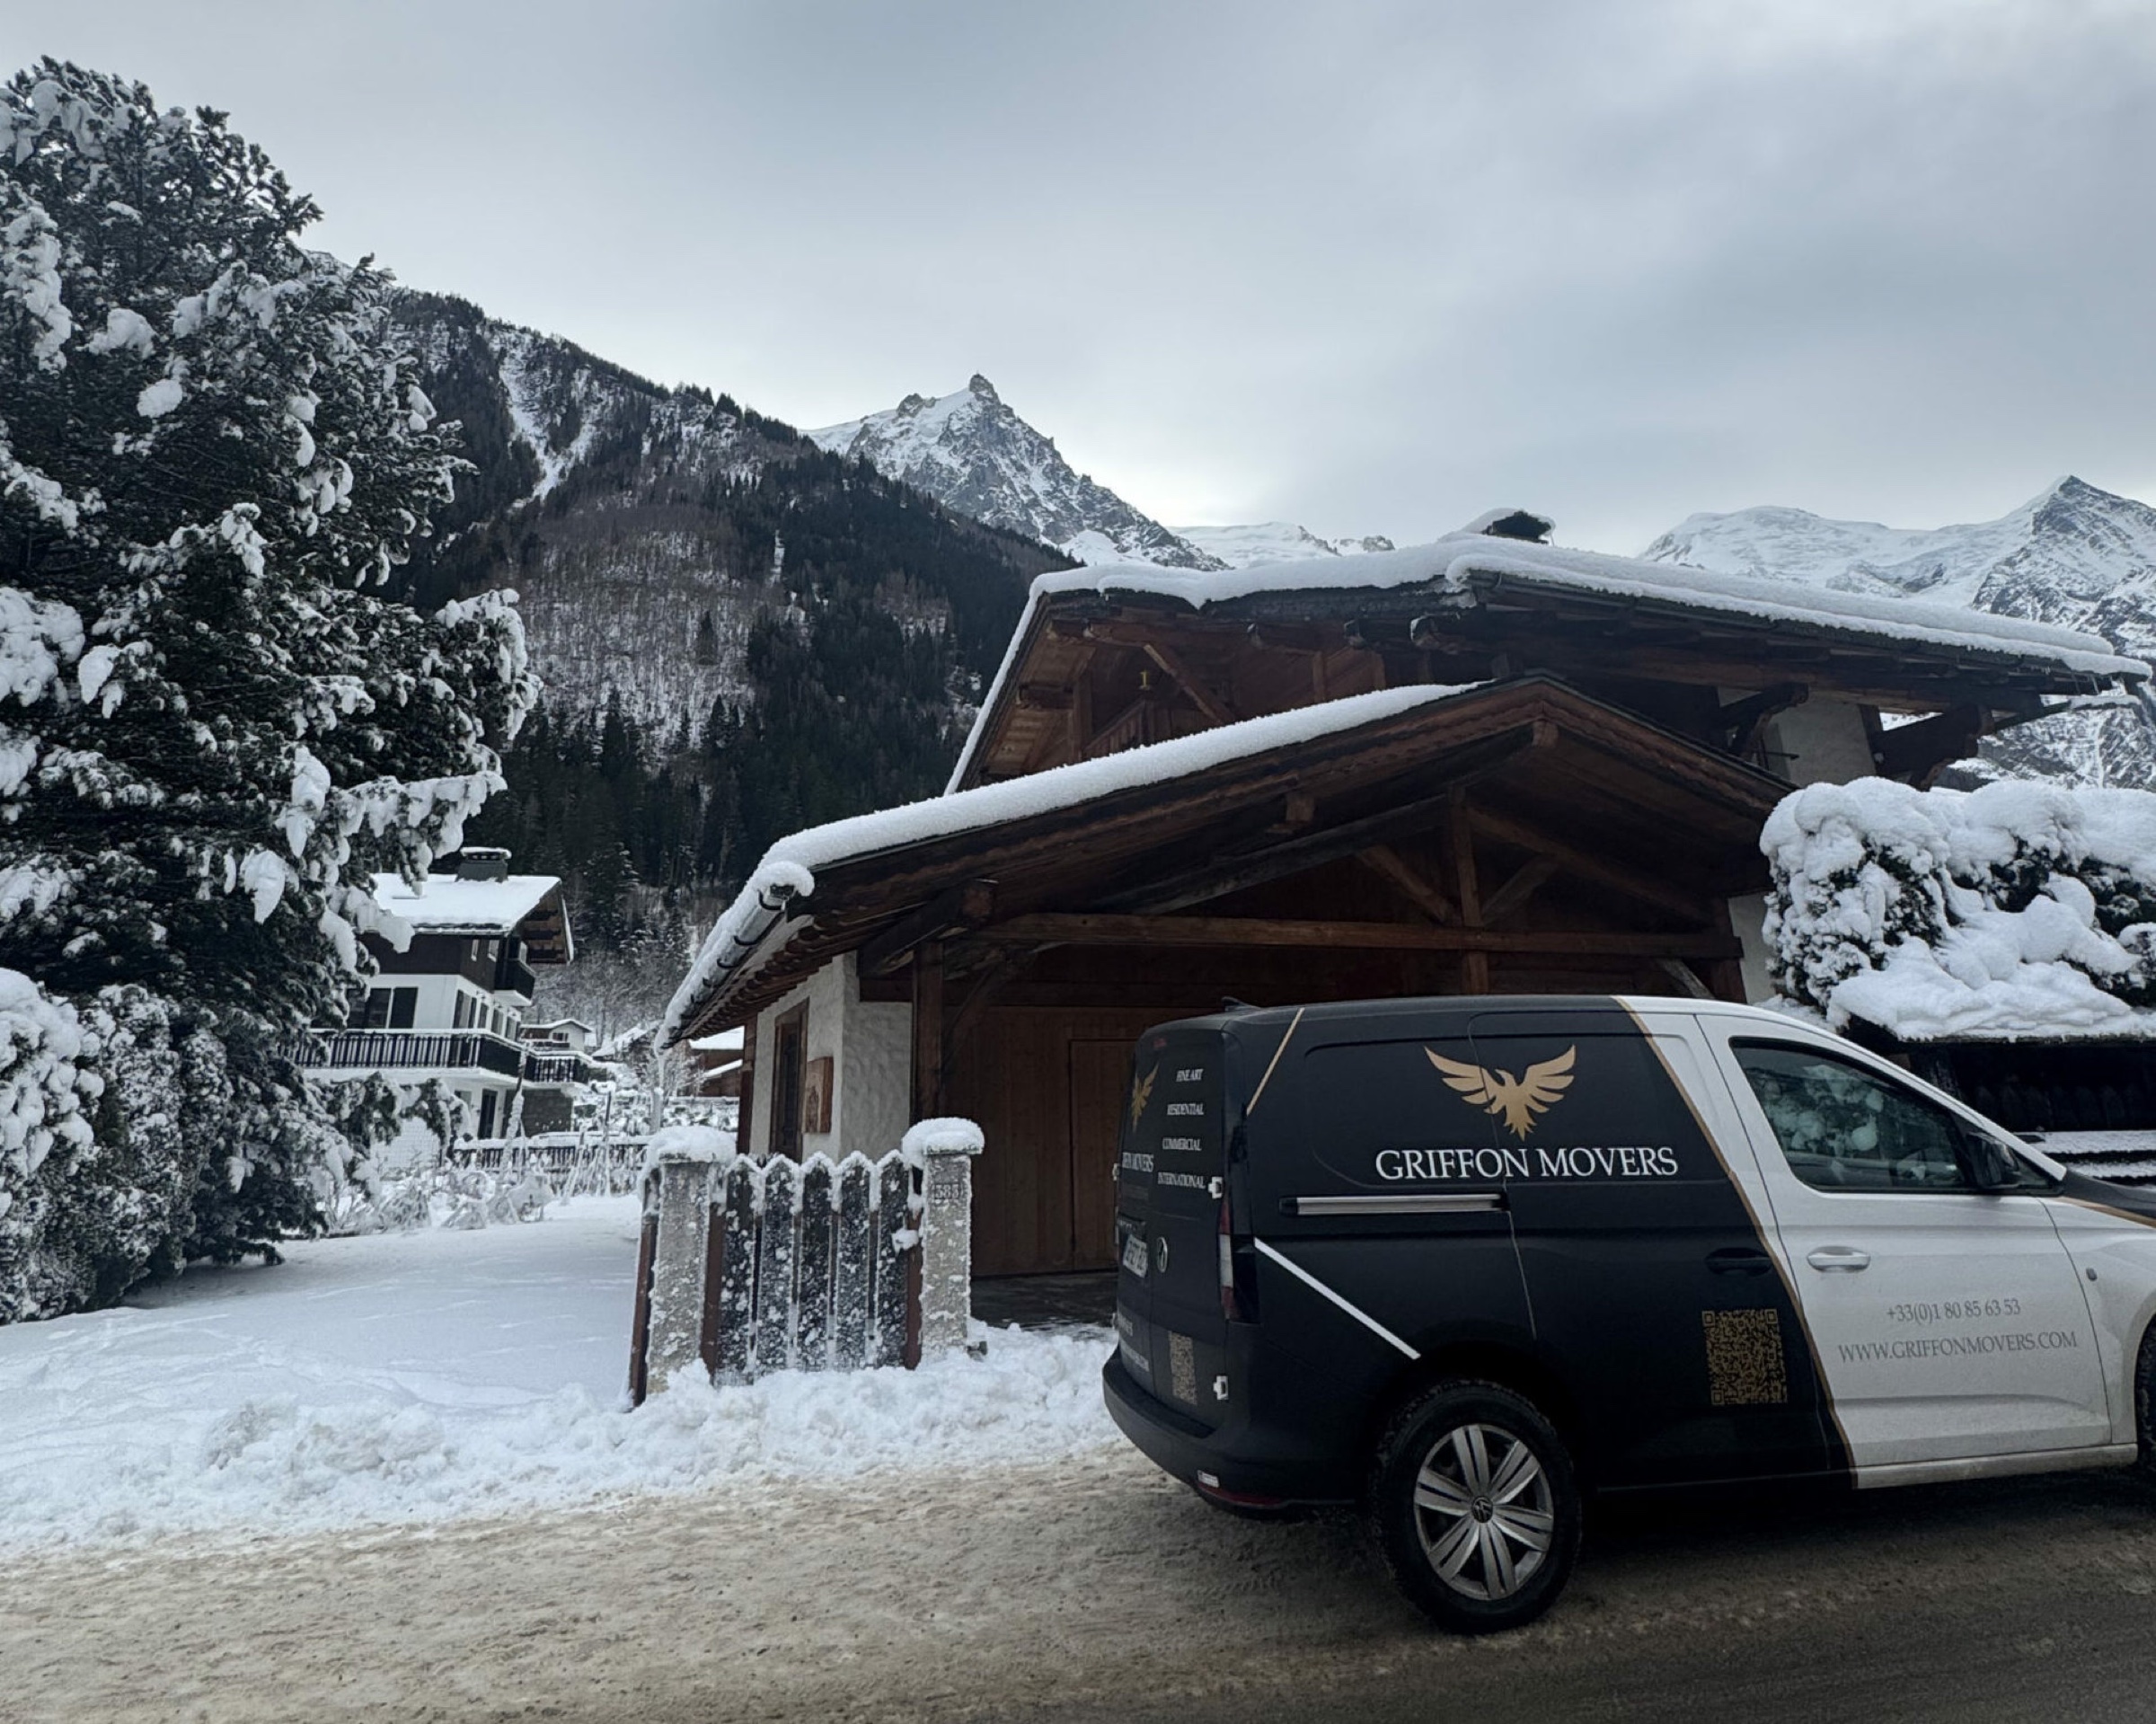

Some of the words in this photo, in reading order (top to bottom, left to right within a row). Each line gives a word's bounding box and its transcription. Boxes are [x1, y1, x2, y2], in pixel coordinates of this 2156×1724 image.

[1167, 1103, 1205, 1115] RESIDENTIAL
[1162, 1137, 1202, 1151] COMMERCIAL
[1375, 1148, 1529, 1180] GRIFFON
[1538, 1146, 1678, 1177] MOVERS
[1157, 1171, 1206, 1189] INTERNATIONAL
[1886, 1303, 1940, 1325] +33(0)1
[1945, 1302, 1962, 1320] 80
[1965, 1300, 1982, 1318] 85
[1985, 1299, 2001, 1317] 63
[2004, 1298, 2020, 1315] 53
[1838, 1331, 2078, 1363] WWW.GRIFFONMOVERS.COM
